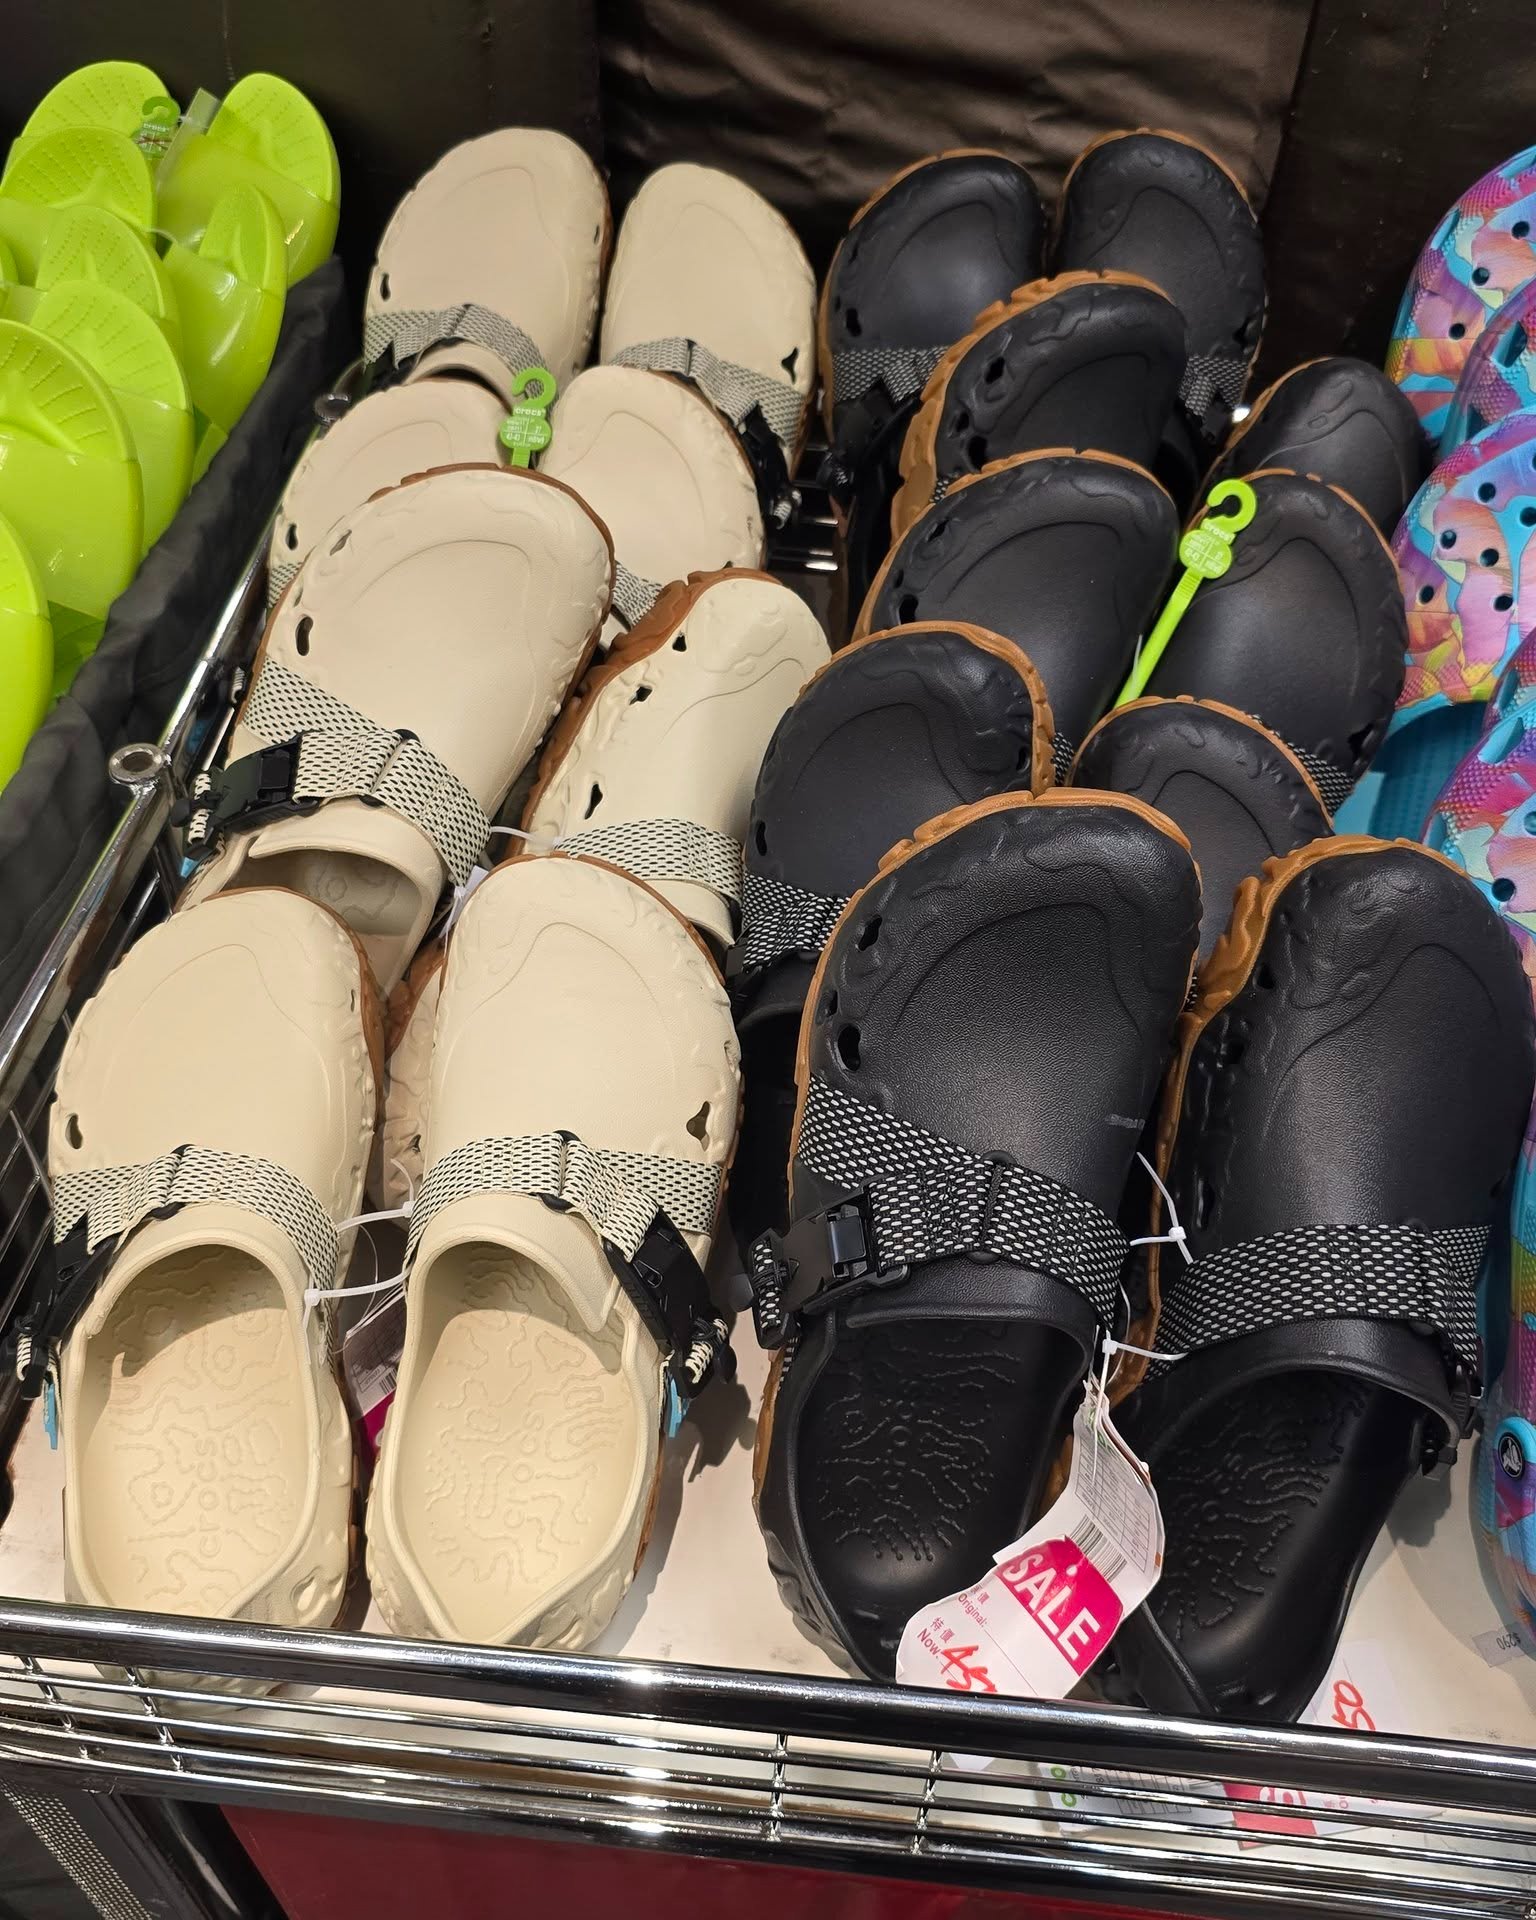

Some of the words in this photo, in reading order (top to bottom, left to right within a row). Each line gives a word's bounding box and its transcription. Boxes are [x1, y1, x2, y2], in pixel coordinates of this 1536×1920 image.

[514, 407, 542, 417] crocs
[195, 1438, 222, 1559] crocs
[1002, 1553, 1101, 1661] SALE
